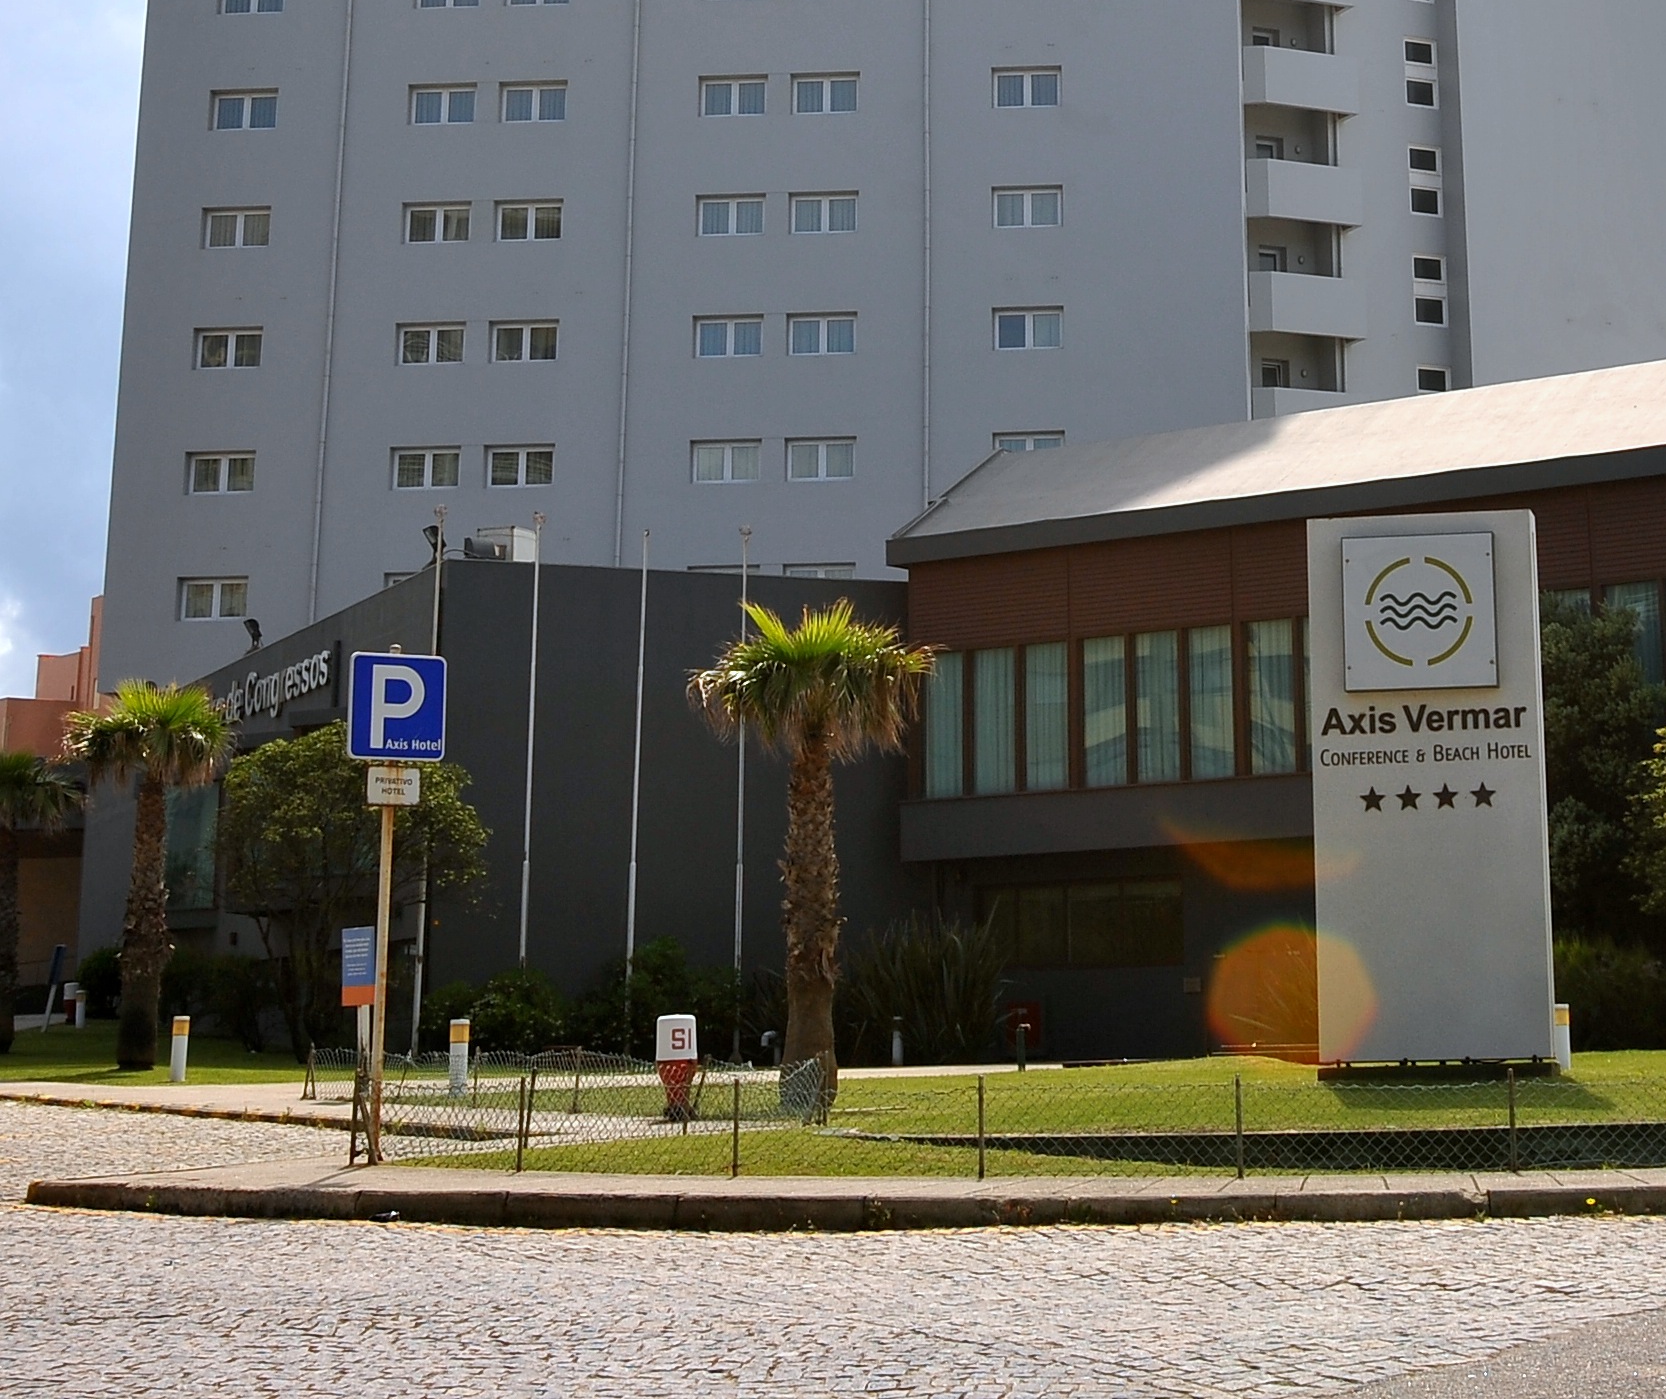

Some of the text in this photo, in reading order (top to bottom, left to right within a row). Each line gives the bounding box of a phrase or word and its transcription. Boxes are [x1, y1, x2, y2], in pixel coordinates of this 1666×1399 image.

[225, 680, 244, 721] de
[245, 650, 331, 718] Congressos
[370, 664, 425, 749] P
[1321, 704, 1527, 736] Axis Vermar
[385, 738, 442, 751] Axis Hotel
[1320, 741, 1532, 767] CONFERENCE & BEACH HOTEL
[375, 776, 413, 786] PRIVATIVO
[381, 787, 406, 796] HOTEL
